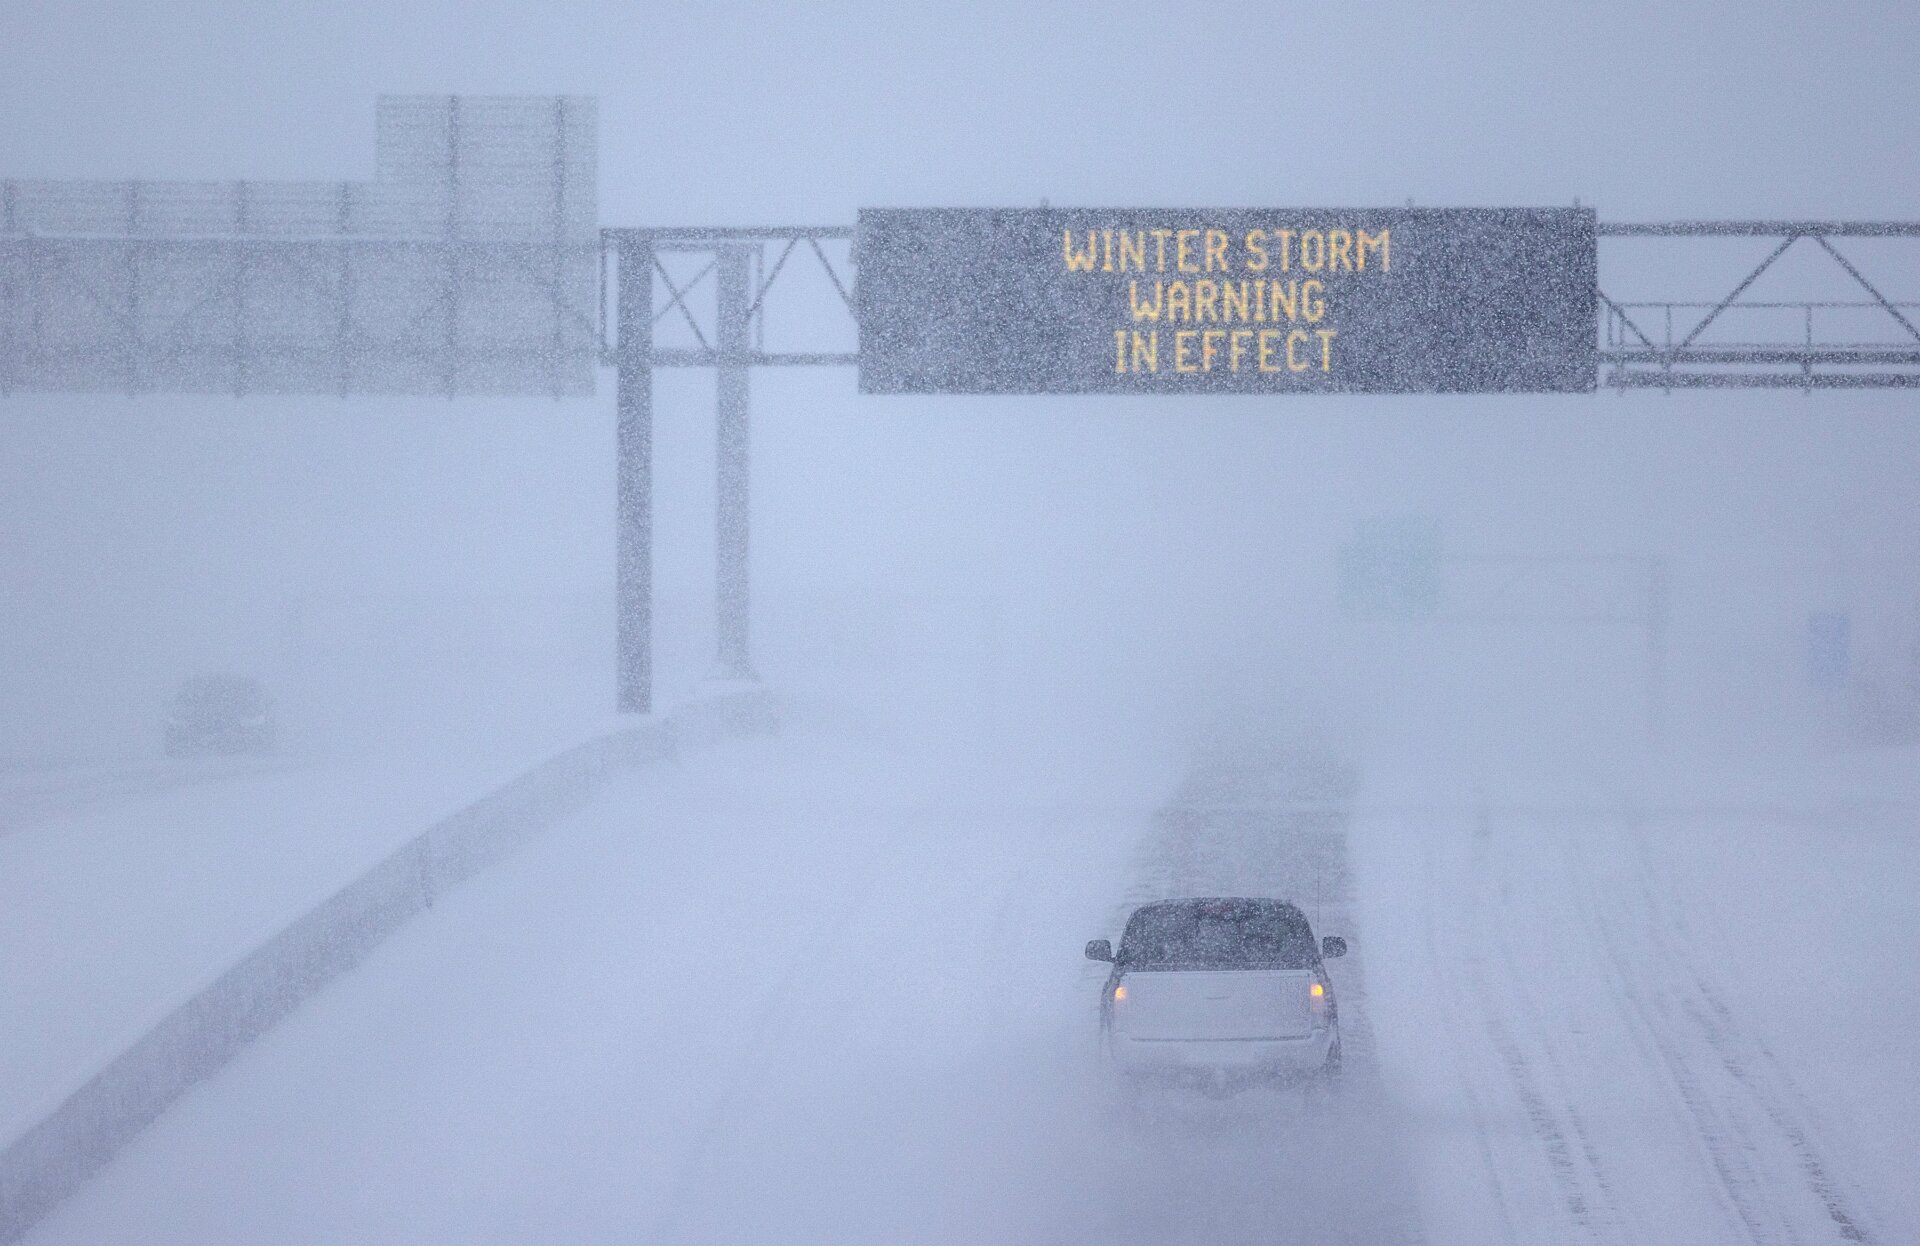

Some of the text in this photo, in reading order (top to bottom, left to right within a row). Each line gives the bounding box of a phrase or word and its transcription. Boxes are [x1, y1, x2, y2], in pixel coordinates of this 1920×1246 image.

[1063, 229, 1390, 273] WINTER STORM
[1129, 279, 1325, 322] WARNING
[1115, 329, 1337, 373] IN EFFECT
